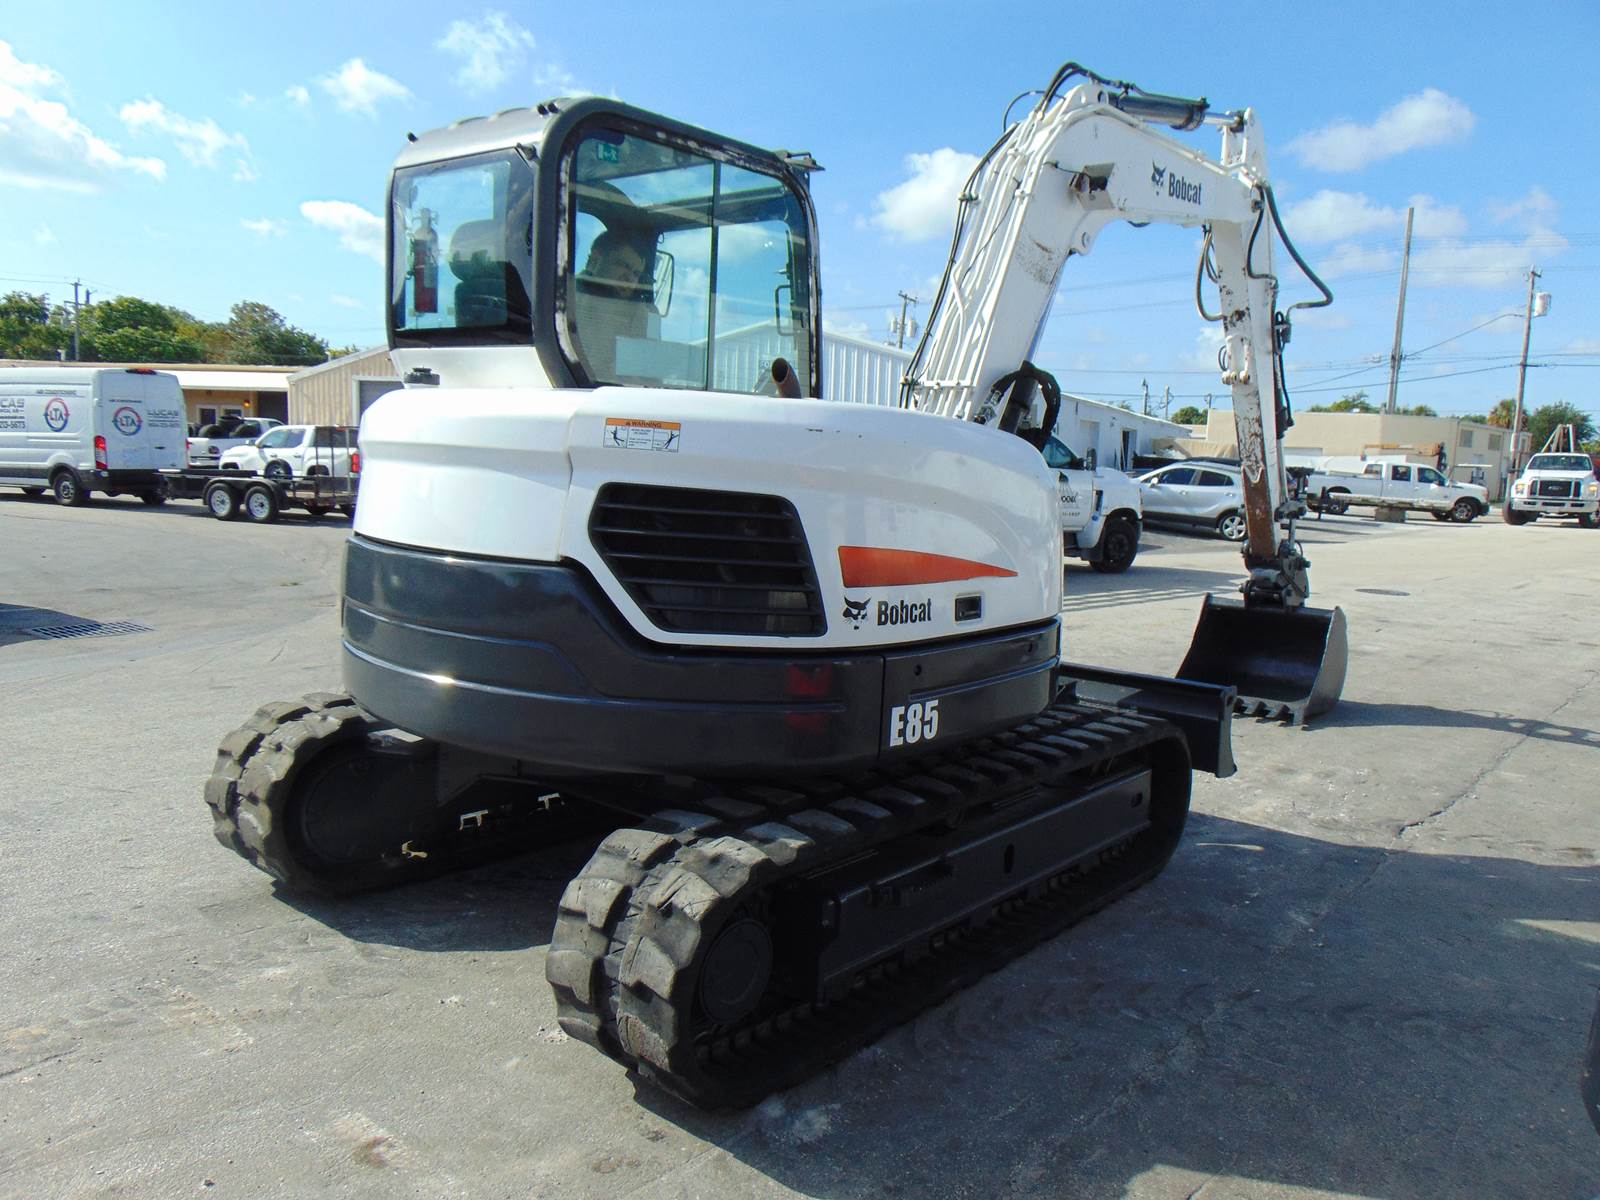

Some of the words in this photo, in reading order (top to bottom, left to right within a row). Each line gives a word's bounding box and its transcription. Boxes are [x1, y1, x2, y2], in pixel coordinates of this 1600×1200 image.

[1168, 172, 1202, 205] Bobcat
[49, 407, 65, 421] LTA
[119, 415, 137, 427] LTA
[632, 420, 662, 429] WARNING
[877, 598, 932, 626] Bobcat
[889, 699, 939, 747] E85
